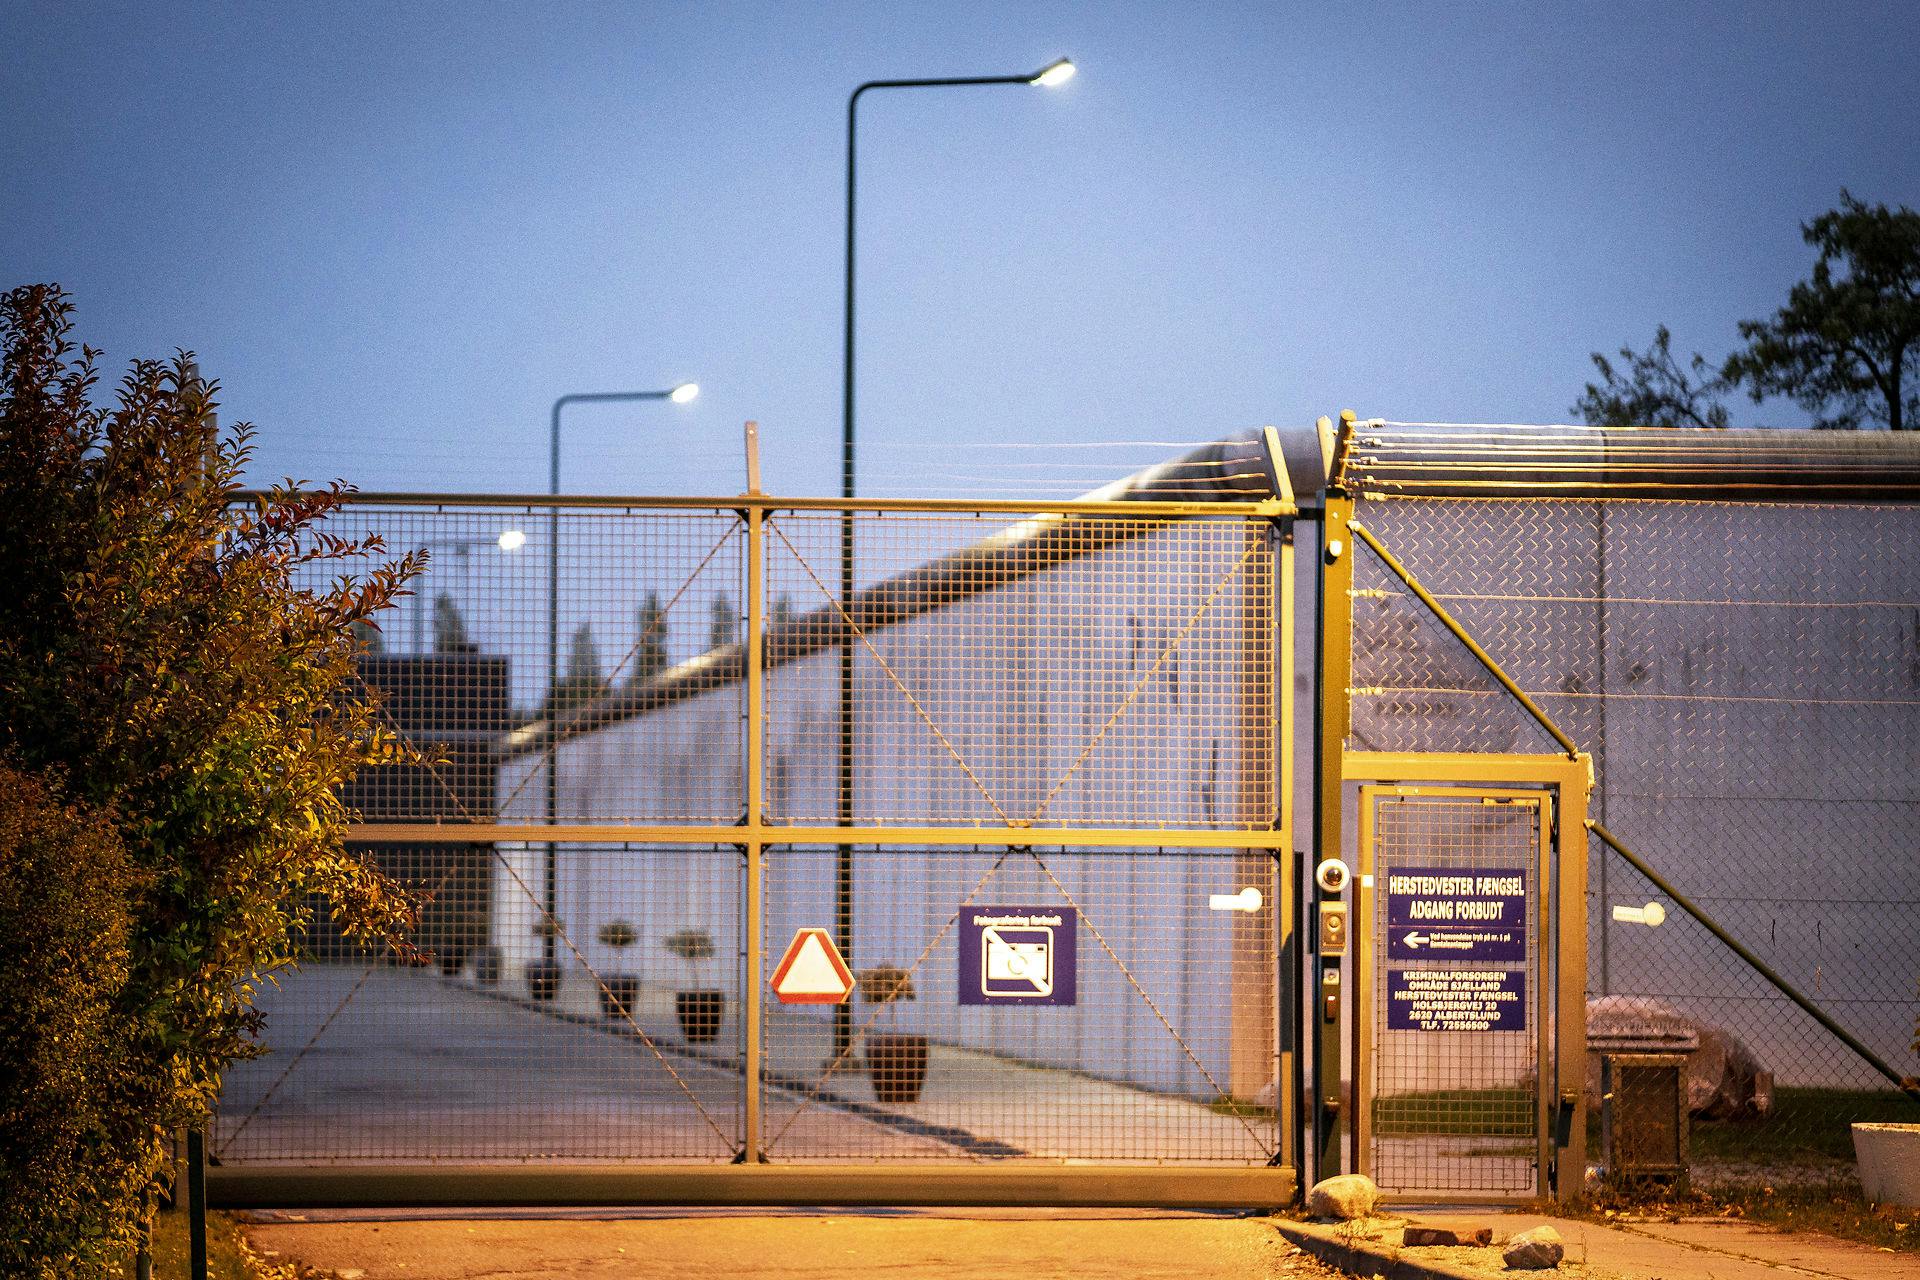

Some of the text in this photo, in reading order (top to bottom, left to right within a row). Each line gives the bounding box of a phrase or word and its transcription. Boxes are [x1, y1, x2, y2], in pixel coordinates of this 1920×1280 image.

[1389, 876, 1525, 896] HERSTEDVESTER FÆNGSEL
[1410, 901, 1504, 920] ADGANG FORBUDT
[1403, 971, 1506, 981] KRIMINALFORSORGEN
[1408, 980, 1501, 991] OMRÅDE SJÆLLAND
[1394, 991, 1519, 1001] HERSTEDVESTER FÆNGSEL
[1485, 1001, 1498, 1011] 20
[1409, 1010, 1501, 1020] 2620 ALBERTSLUND
